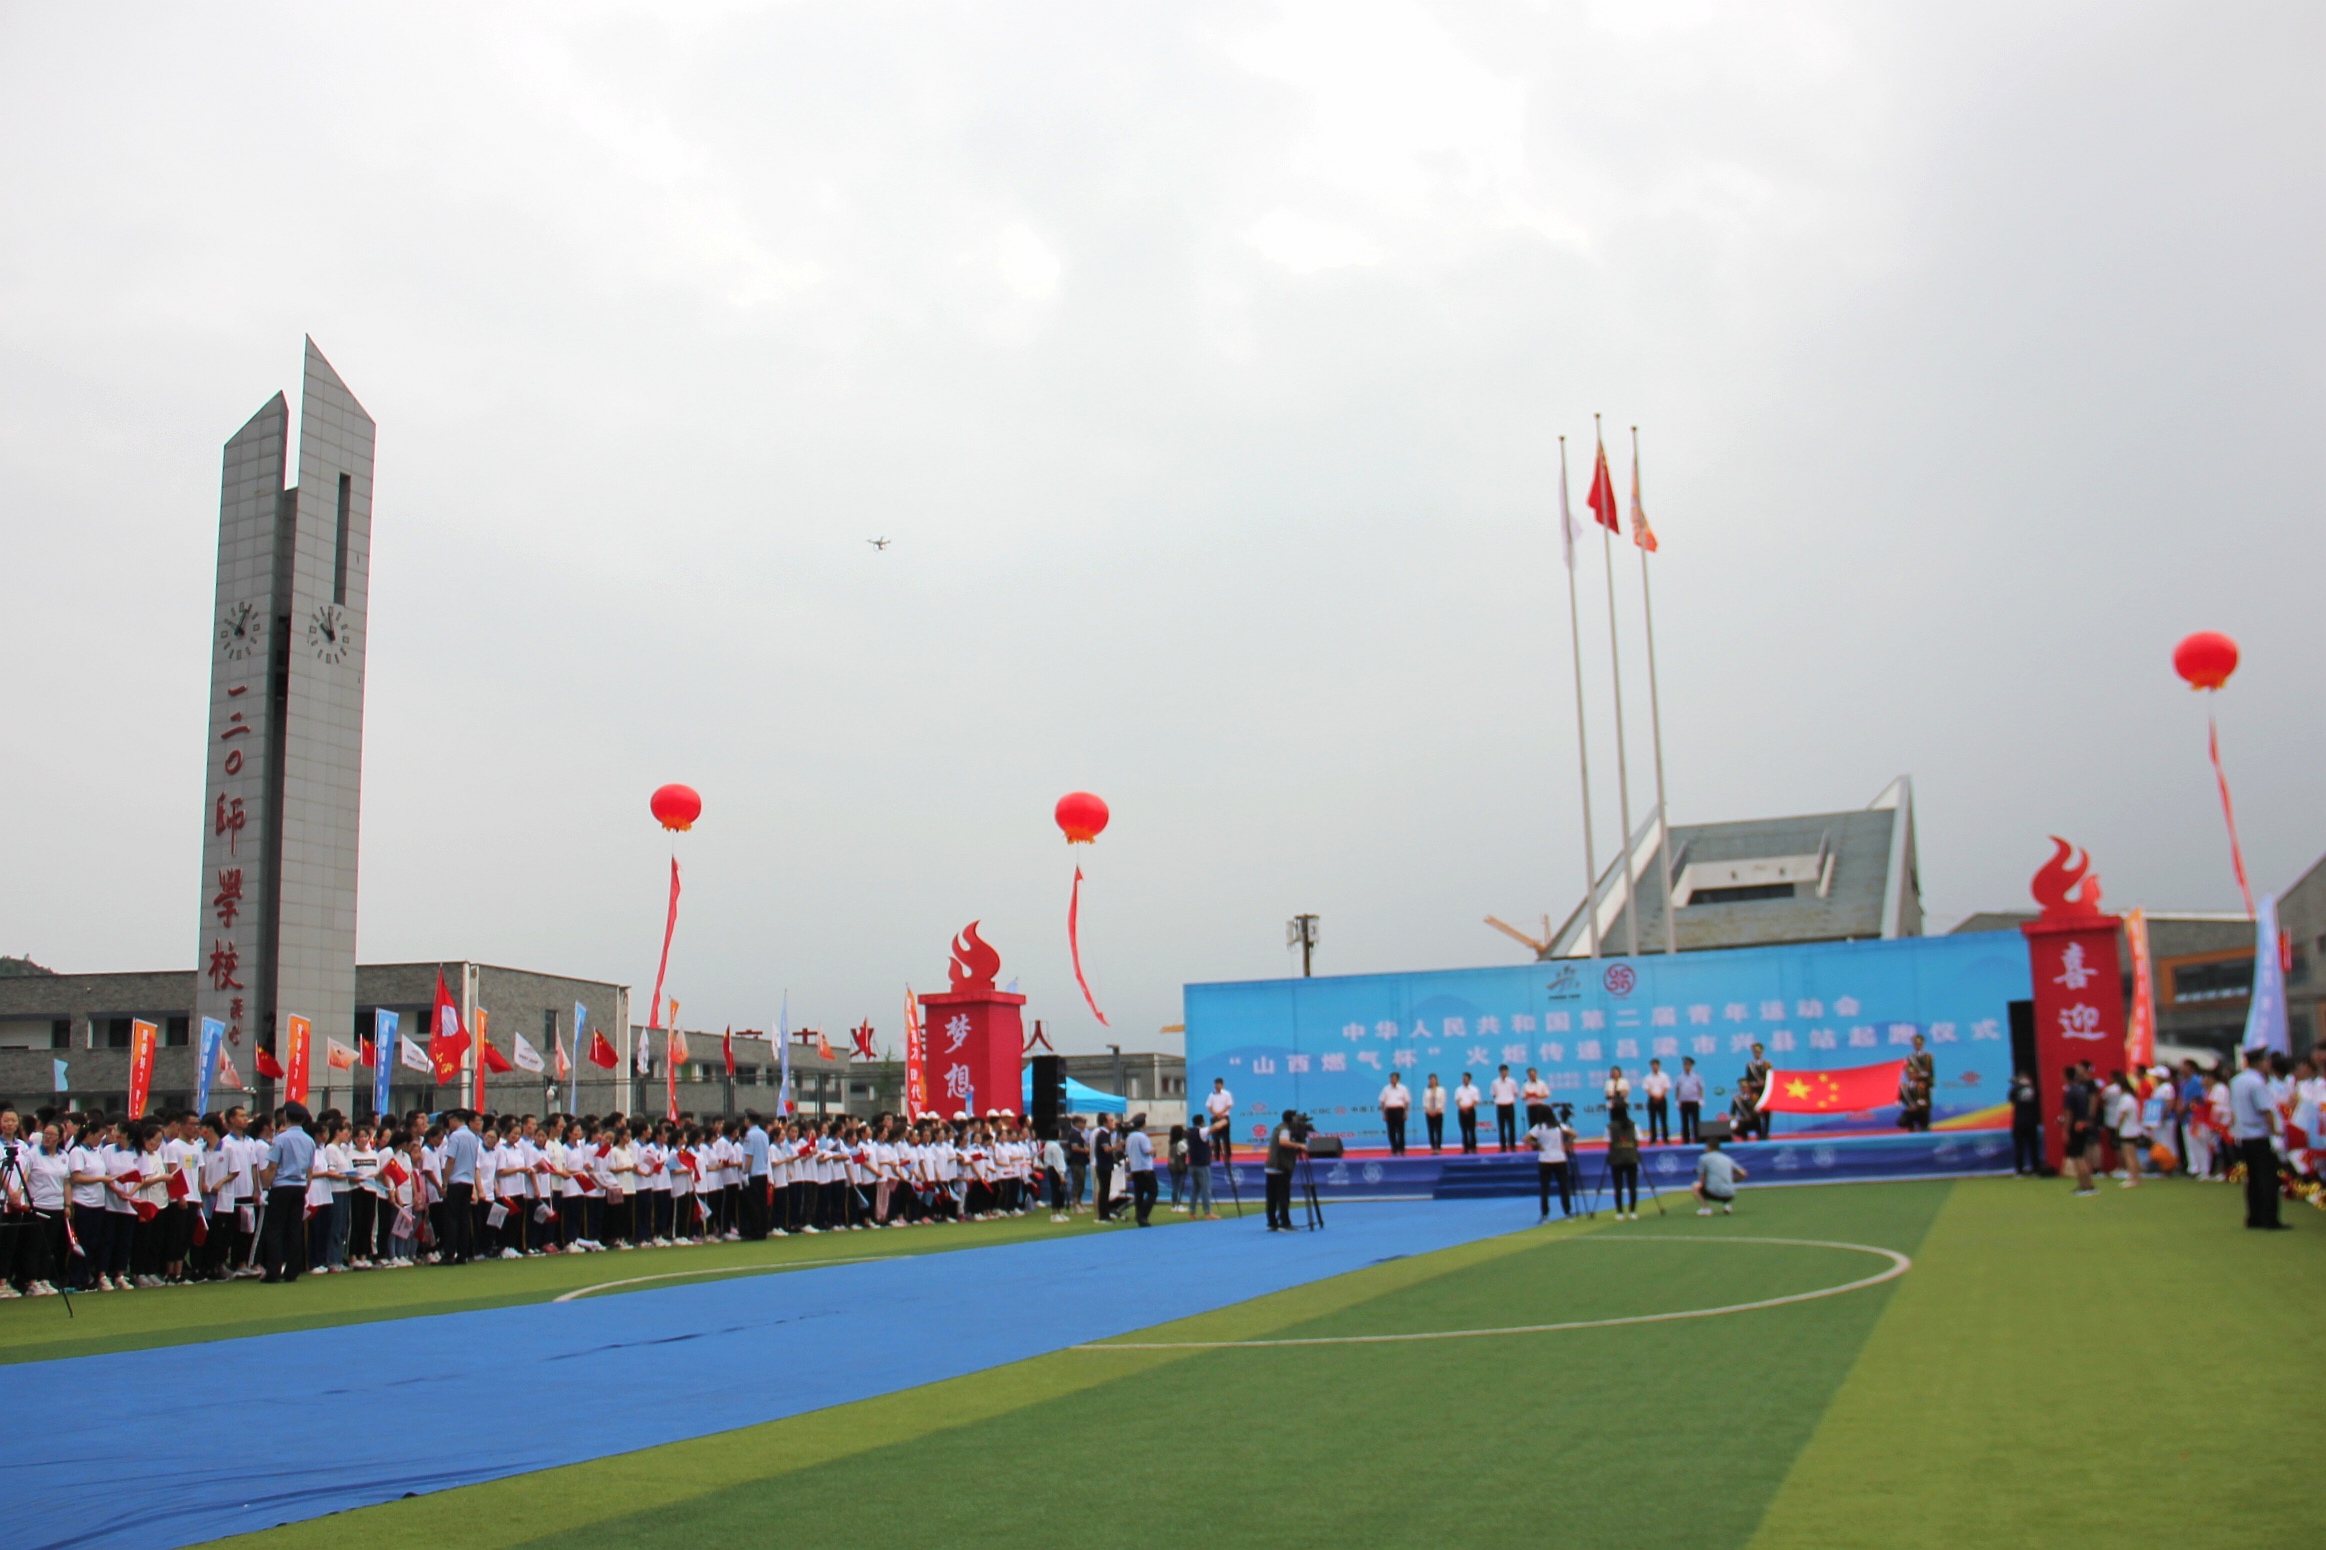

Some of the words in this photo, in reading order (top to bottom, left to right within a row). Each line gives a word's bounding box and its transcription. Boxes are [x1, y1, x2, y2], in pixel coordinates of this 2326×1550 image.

[1342, 995, 1860, 1042] 中华人民共和国第二届青年运动会
[2053, 942, 2108, 1041] 喜迎
[944, 1012, 975, 1099] 梦想
